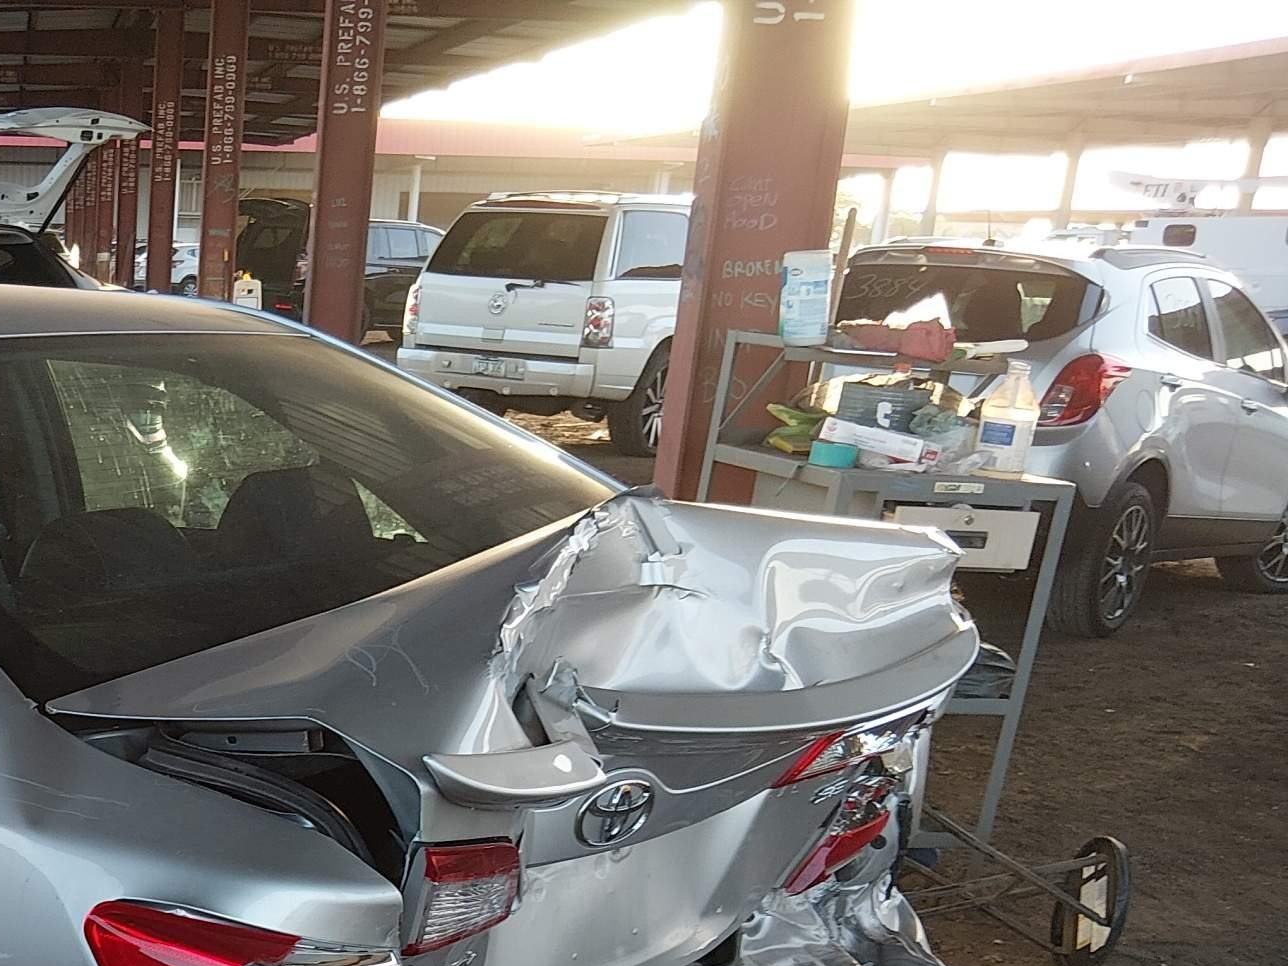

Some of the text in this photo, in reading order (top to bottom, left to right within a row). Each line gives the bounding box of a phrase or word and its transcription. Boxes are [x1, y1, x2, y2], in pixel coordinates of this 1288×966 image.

[332, 0, 356, 115] U.S. PREFA
[211, 141, 223, 165] U.S.
